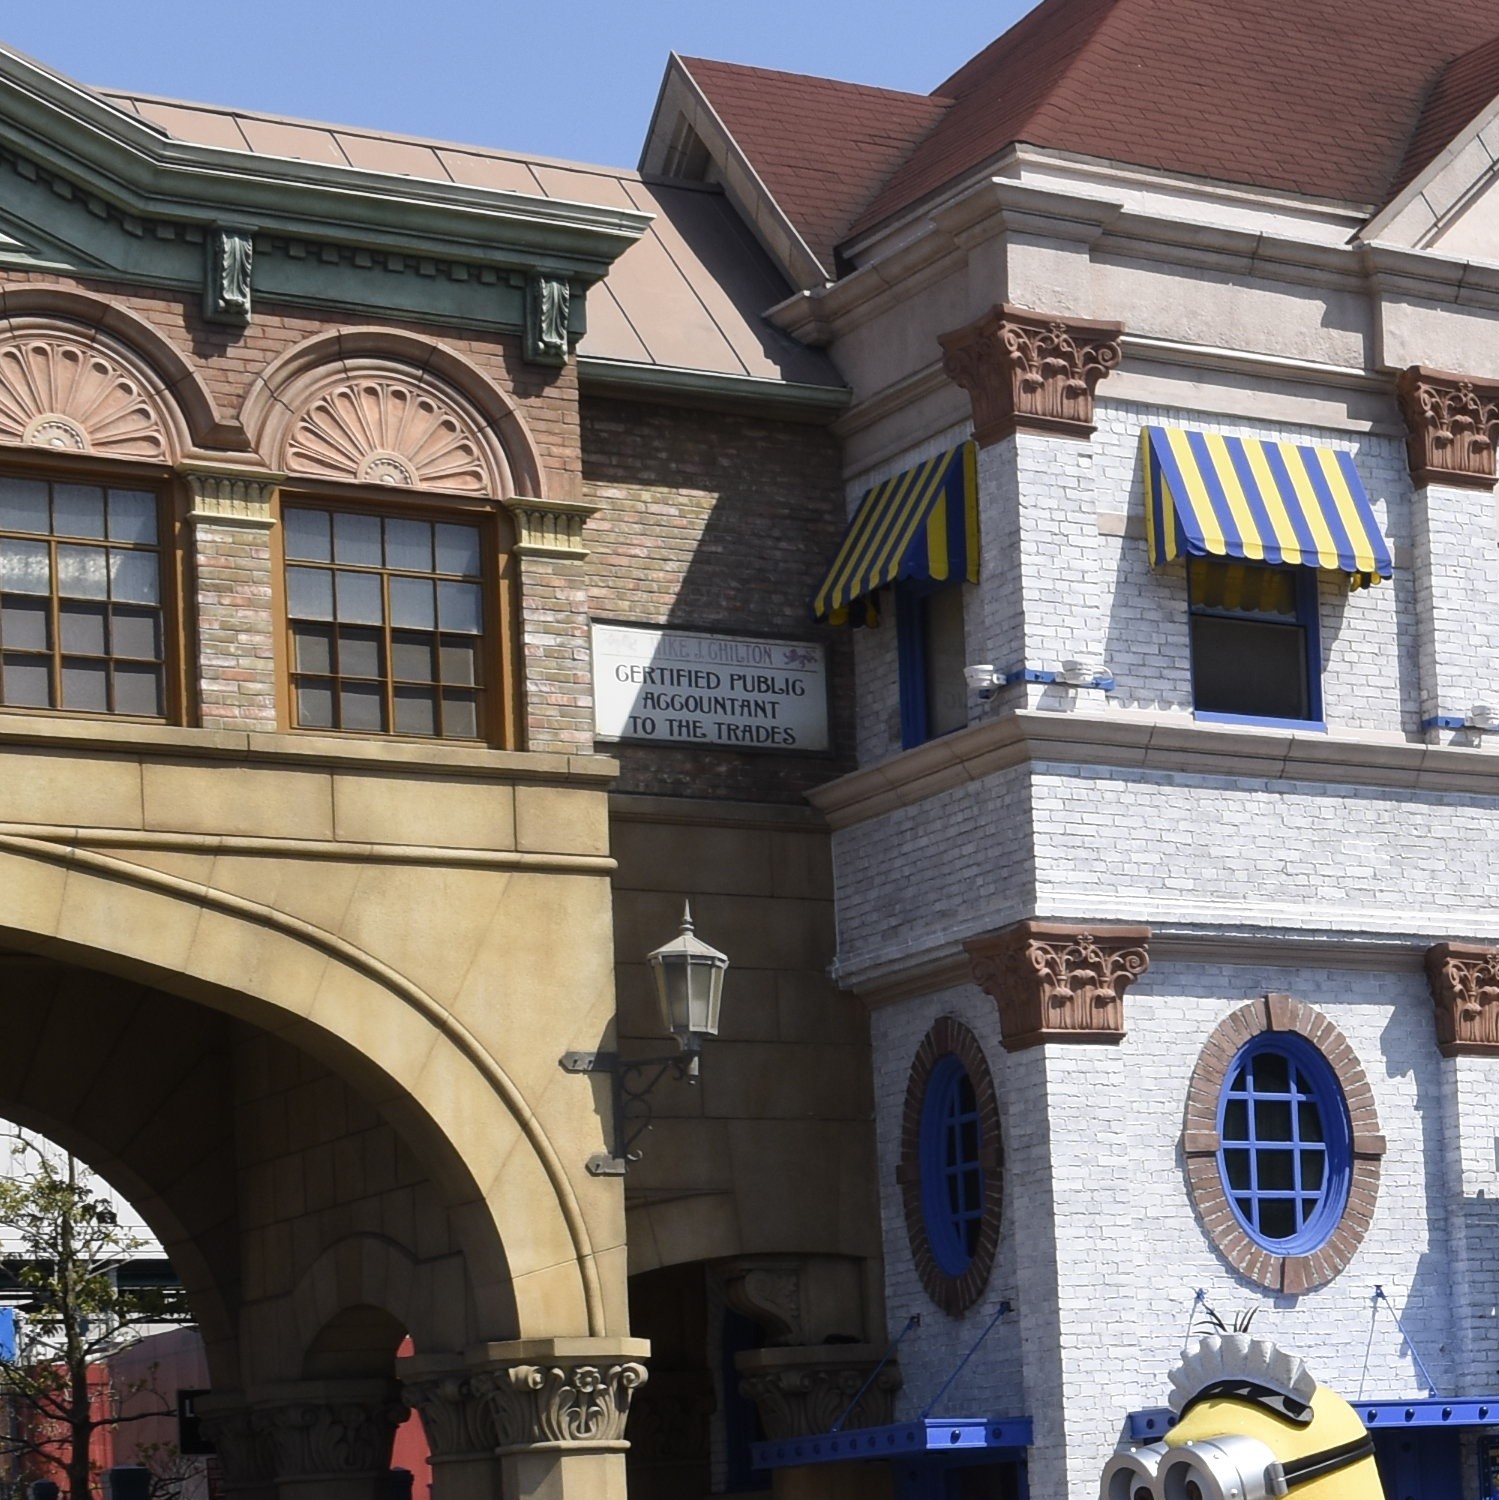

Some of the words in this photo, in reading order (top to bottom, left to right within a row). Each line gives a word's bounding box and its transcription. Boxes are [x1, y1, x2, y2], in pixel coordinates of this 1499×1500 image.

[615, 665, 721, 690] CERTIFIED
[730, 673, 806, 697] PUBLIC
[642, 692, 780, 719] ACCOUNTANT
[629, 716, 656, 735] TO
[665, 719, 707, 738] THE
[713, 722, 796, 745] TRADES
